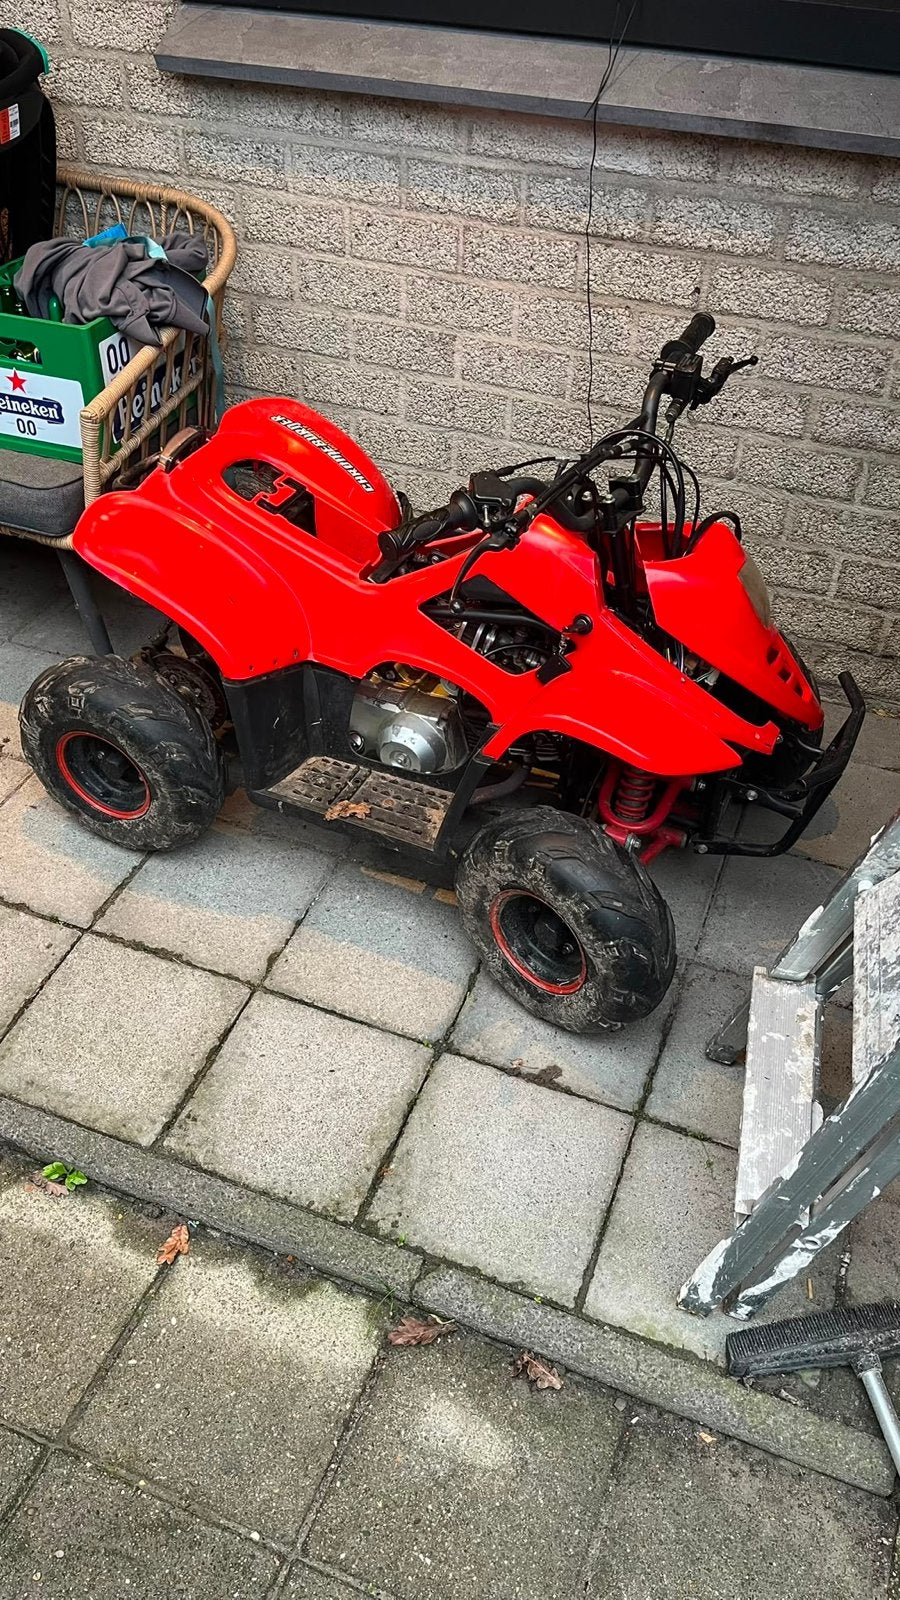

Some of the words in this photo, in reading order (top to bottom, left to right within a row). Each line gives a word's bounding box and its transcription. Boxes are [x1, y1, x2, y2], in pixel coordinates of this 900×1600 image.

[107, 336, 131, 375] 0.0
[0, 395, 60, 420] eineken
[16, 418, 37, 436] 0.0
[270, 414, 375, 493] CHROMEBURNER
